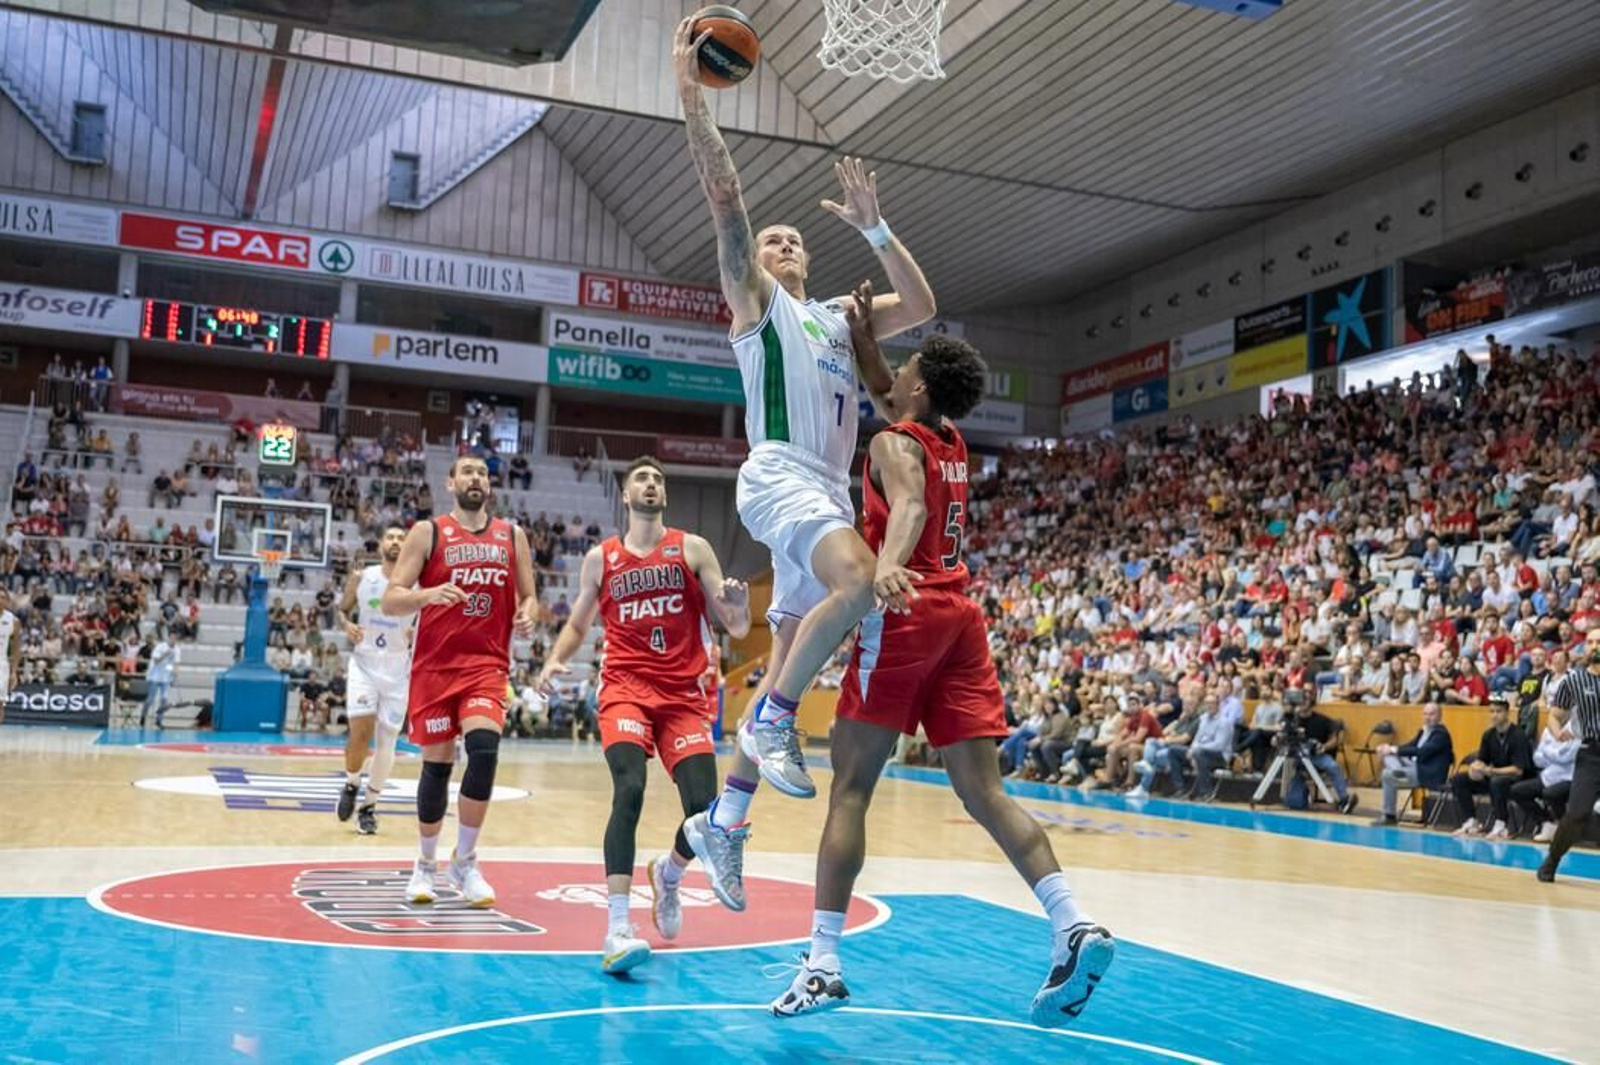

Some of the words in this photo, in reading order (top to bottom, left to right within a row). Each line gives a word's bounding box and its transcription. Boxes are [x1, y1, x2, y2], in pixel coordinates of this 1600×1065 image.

[175, 224, 307, 263] SPAR
[404, 255, 456, 286] LLEAL
[629, 293, 719, 314] ESPORTIVES
[554, 318, 650, 350] Panella
[396, 335, 499, 365] parlem
[264, 437, 291, 457] 22
[941, 502, 963, 570] 5
[444, 542, 509, 566] GIRONA
[450, 567, 509, 587] FIATC
[610, 563, 685, 600] GIRONA
[463, 592, 491, 617] 33
[619, 593, 684, 623] FIATC
[376, 633, 387, 648] 6
[650, 626, 666, 654] 4
[5, 688, 104, 711] ndesa
